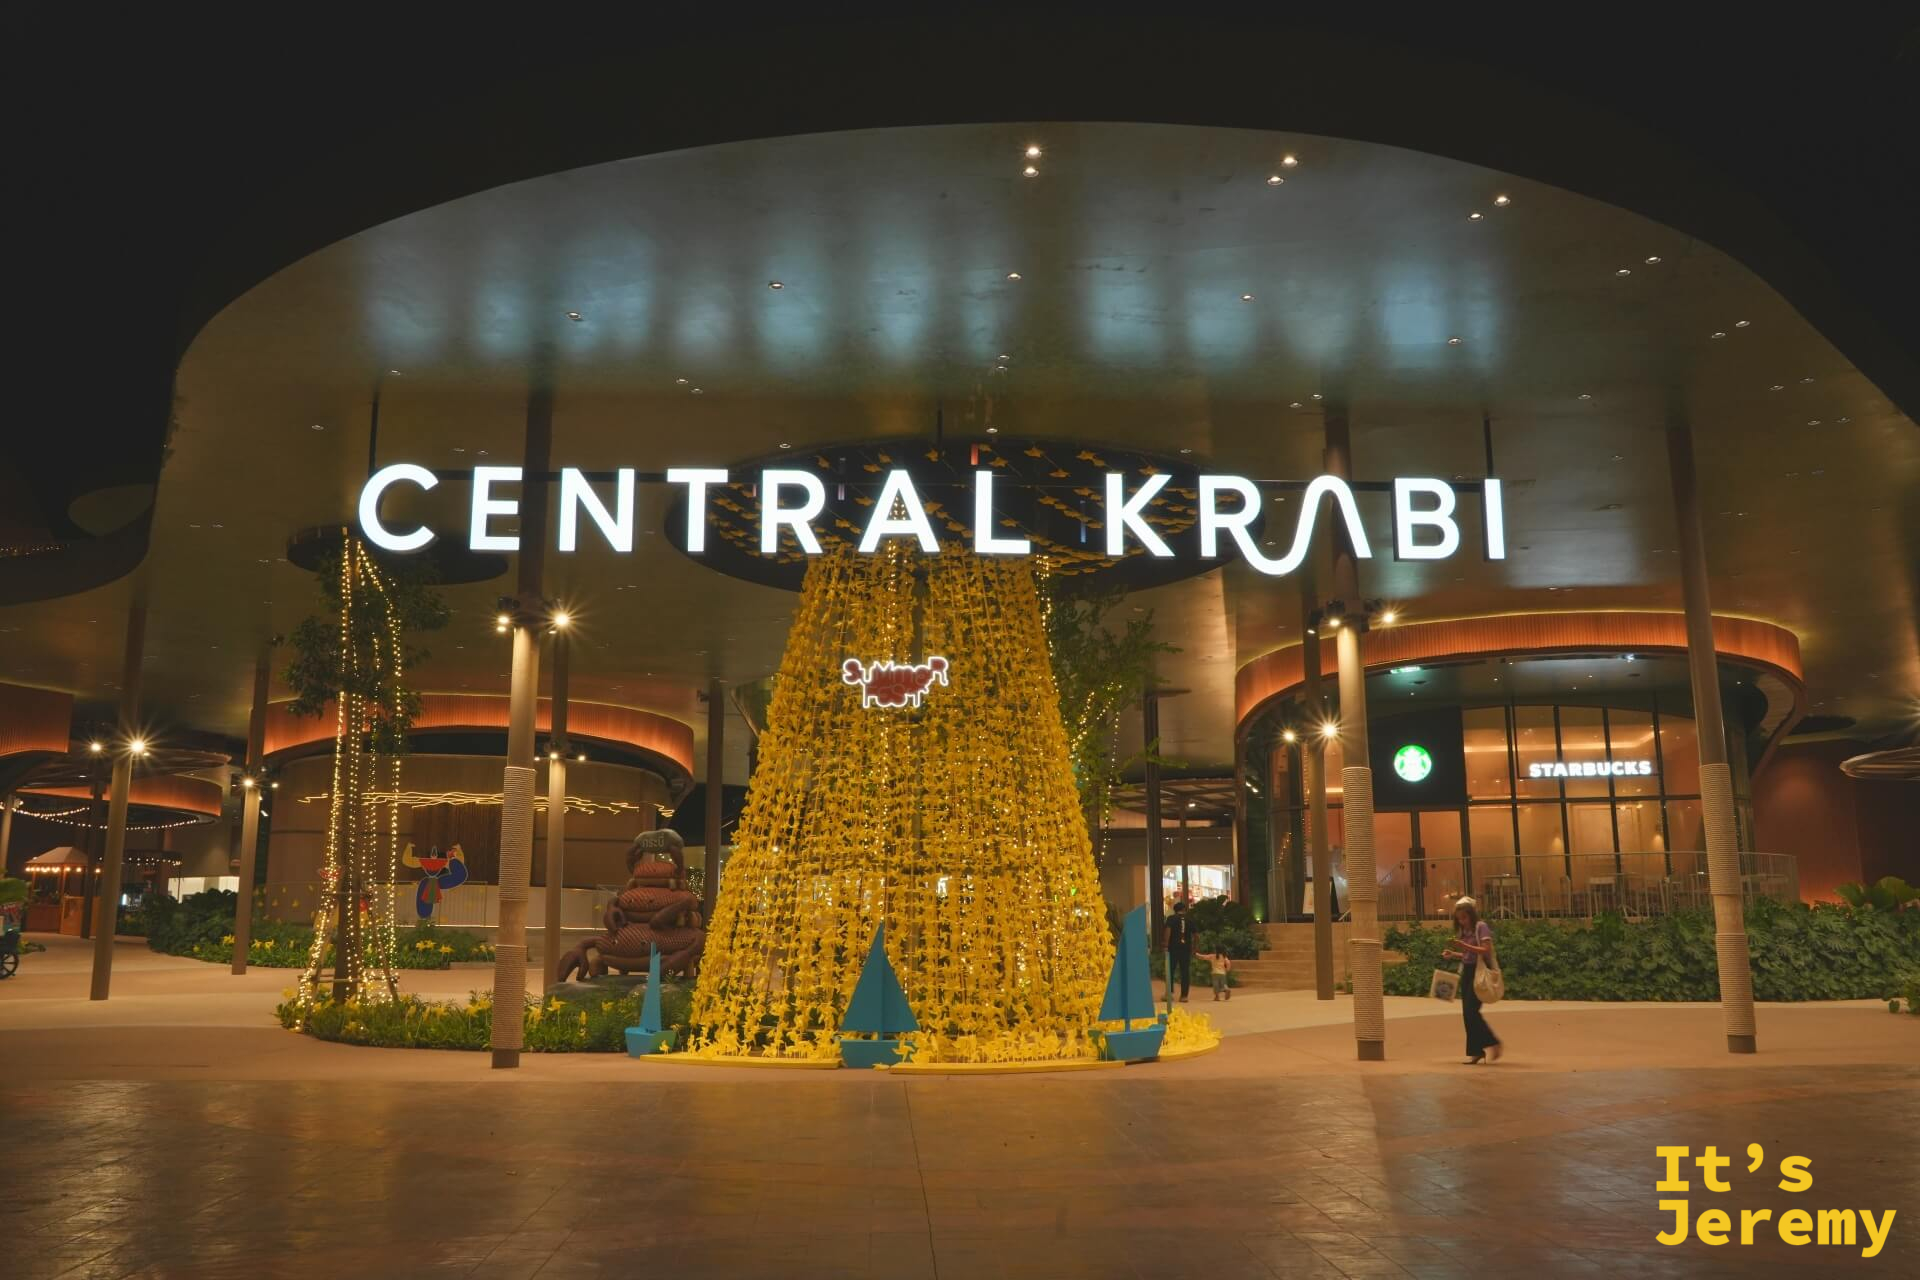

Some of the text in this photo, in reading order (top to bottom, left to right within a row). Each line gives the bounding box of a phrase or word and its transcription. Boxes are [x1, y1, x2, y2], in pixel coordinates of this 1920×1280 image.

[359, 463, 1505, 576] CENTRAL KRABI
[1528, 760, 1652, 778] STARBUCKS
